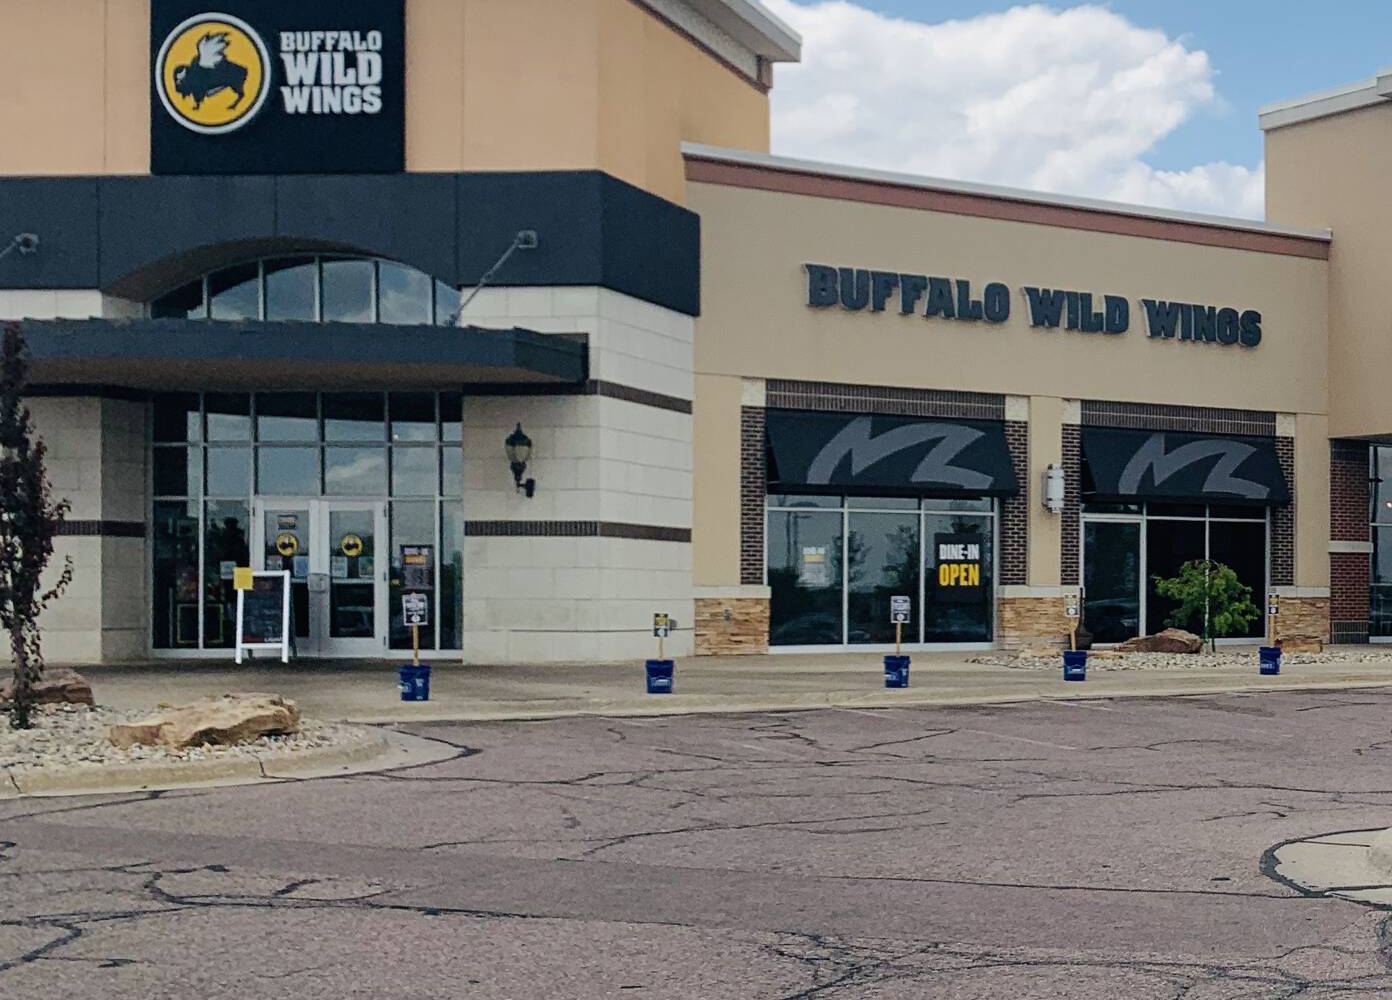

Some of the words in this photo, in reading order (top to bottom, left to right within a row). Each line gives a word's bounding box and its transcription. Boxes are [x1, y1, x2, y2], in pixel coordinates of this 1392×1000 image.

[280, 30, 382, 52] BUFFALO
[280, 51, 382, 86] WILD
[280, 86, 382, 114] WINGS
[805, 263, 1011, 324] BUFFALO
[1024, 286, 1130, 335] WILD
[1141, 298, 1263, 348] WINGS
[938, 543, 980, 561] DINE-IN
[938, 563, 980, 587] OPEN
